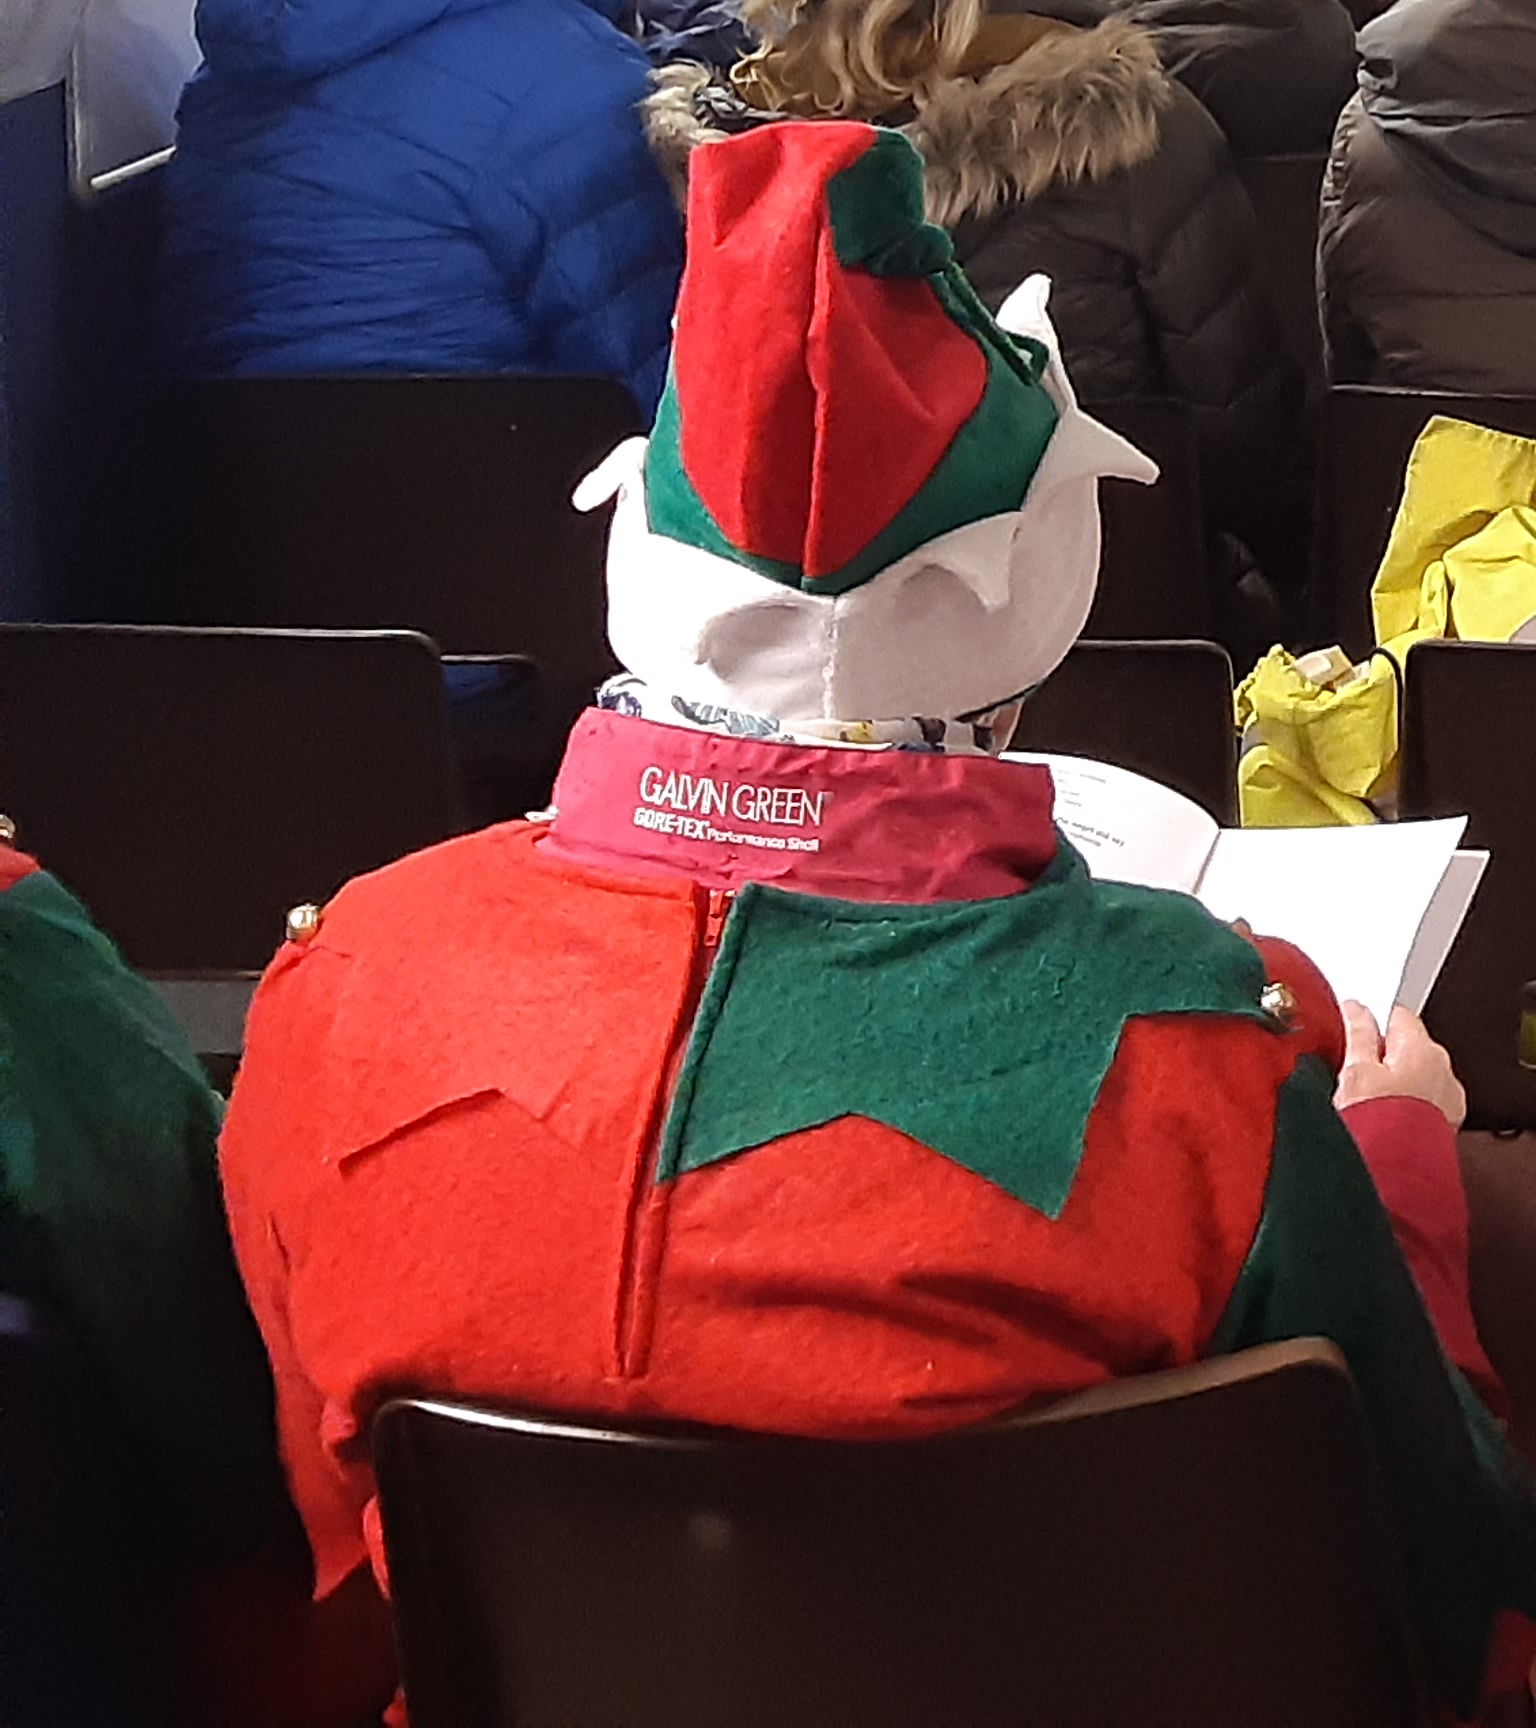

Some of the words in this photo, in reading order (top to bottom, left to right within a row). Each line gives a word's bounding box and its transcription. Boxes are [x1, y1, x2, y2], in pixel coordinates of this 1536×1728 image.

[640, 766, 729, 816] GALVIN
[731, 784, 823, 827] GREEN
[633, 807, 710, 840] GORE-TEX
